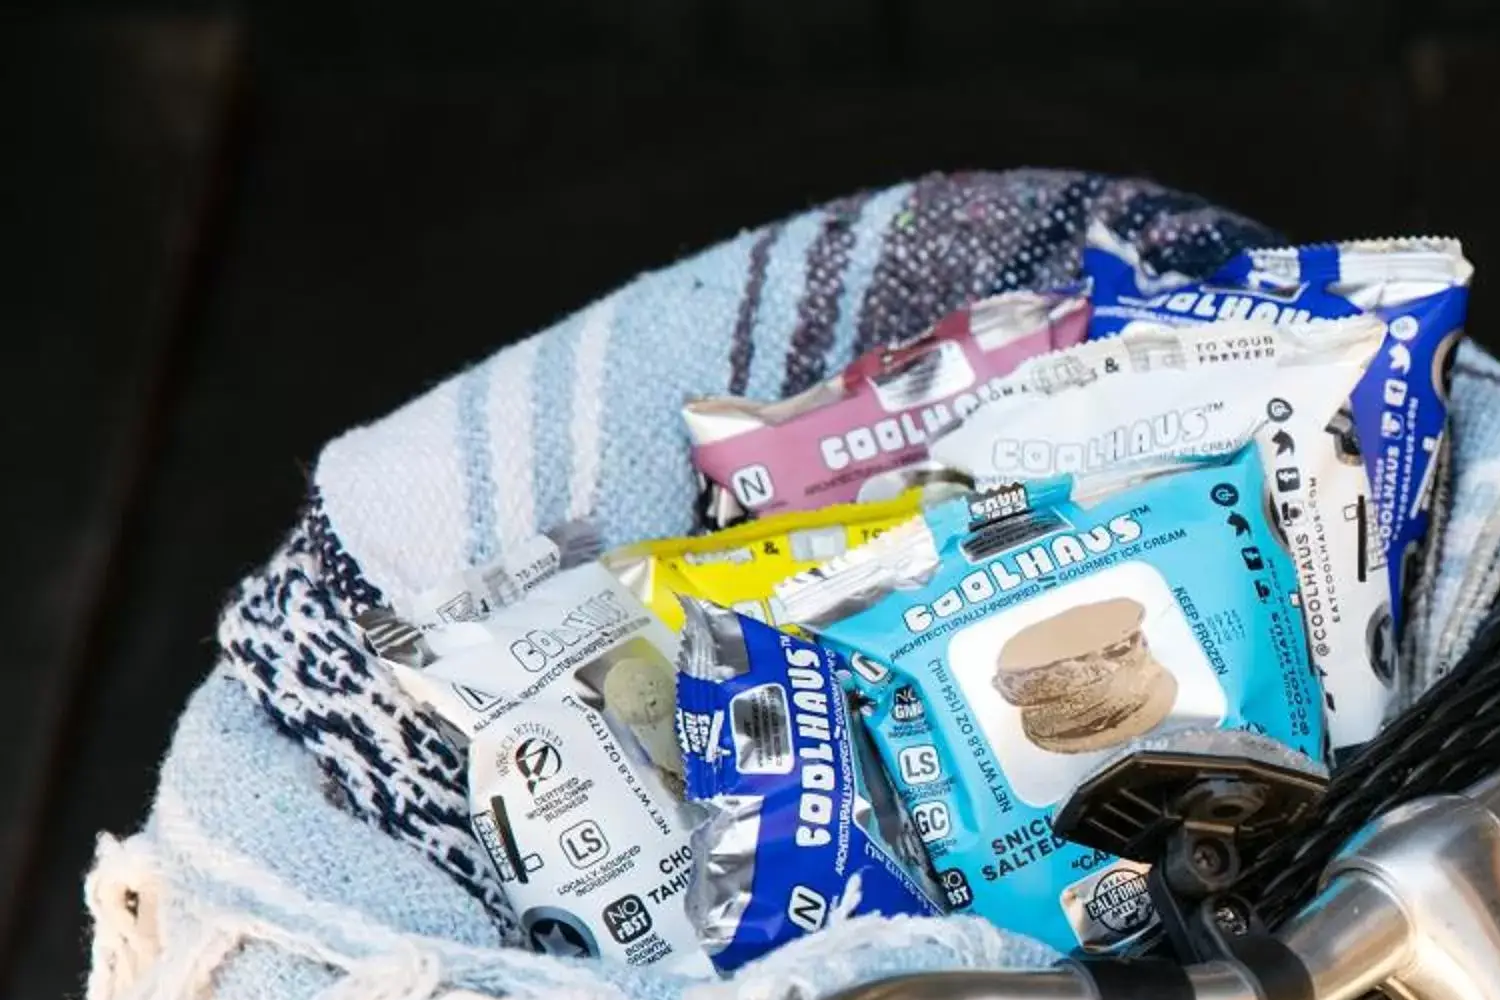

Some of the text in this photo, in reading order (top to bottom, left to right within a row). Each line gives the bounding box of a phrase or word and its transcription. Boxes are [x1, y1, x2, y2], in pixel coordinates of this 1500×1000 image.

[1057, 553, 1120, 583] GOURMET
[1142, 528, 1188, 551] CREAM
[1295, 533, 1330, 657] @COOLHAUS
[1173, 586, 1200, 621] KEEP
[1192, 622, 1229, 675] FROZEN
[955, 711, 975, 737] OZ
[903, 750, 938, 778] LS
[979, 759, 1002, 790] WT
[992, 790, 1014, 815] NET
[915, 805, 947, 836] GC
[565, 826, 602, 863] LS
[607, 899, 640, 924] NO
[616, 916, 648, 940] rBST
